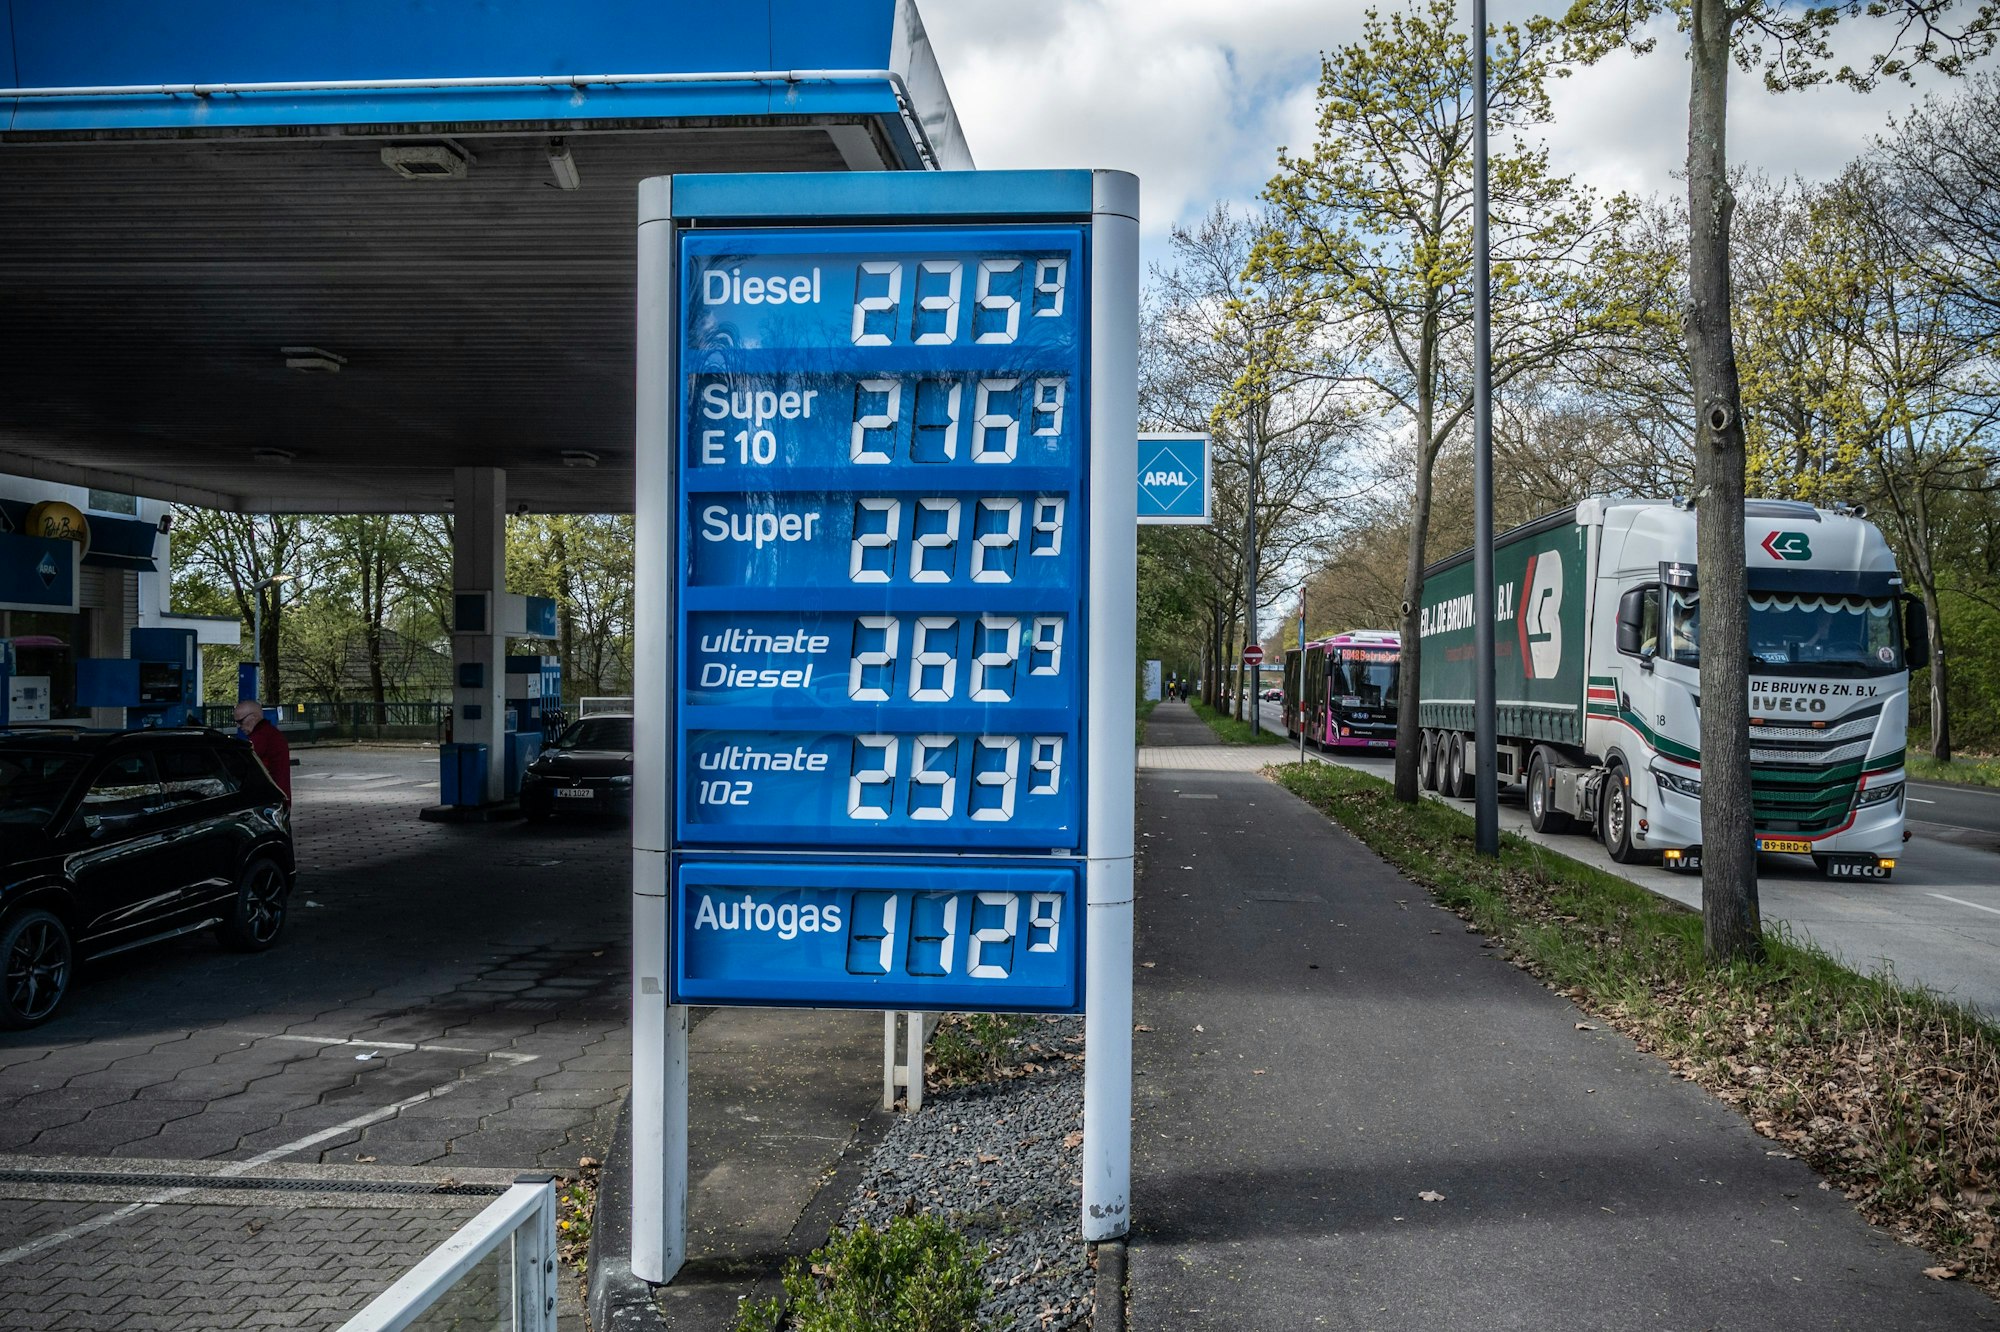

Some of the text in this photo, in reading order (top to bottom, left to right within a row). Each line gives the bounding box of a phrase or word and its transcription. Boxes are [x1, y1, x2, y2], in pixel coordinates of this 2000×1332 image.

[703, 267, 821, 305] Diesel
[703, 383, 818, 427] Super
[703, 430, 777, 465] E 10
[1143, 471, 1188, 487] ARAL
[703, 505, 820, 549] Super
[39, 564, 57, 575] ARAL
[1437, 602, 1447, 634] DE
[1446, 594, 1473, 632] BRUYN
[1498, 582, 1514, 622] B.V.
[701, 628, 830, 654] ultimate
[1341, 649, 1401, 663] RB48 Betriebsf
[700, 663, 813, 689] Diesel
[1751, 681, 1878, 697] DE BRUYN & ZN. B.V.
[1752, 696, 1826, 713] IVECO
[1656, 714, 1666, 726] 18
[699, 745, 828, 771] ultimate
[699, 780, 753, 806] 102
[1763, 841, 1809, 852] 89-BRD-6
[1669, 857, 1703, 868] IVE
[1832, 863, 1886, 877] IVECO
[694, 895, 842, 940] Autogas
